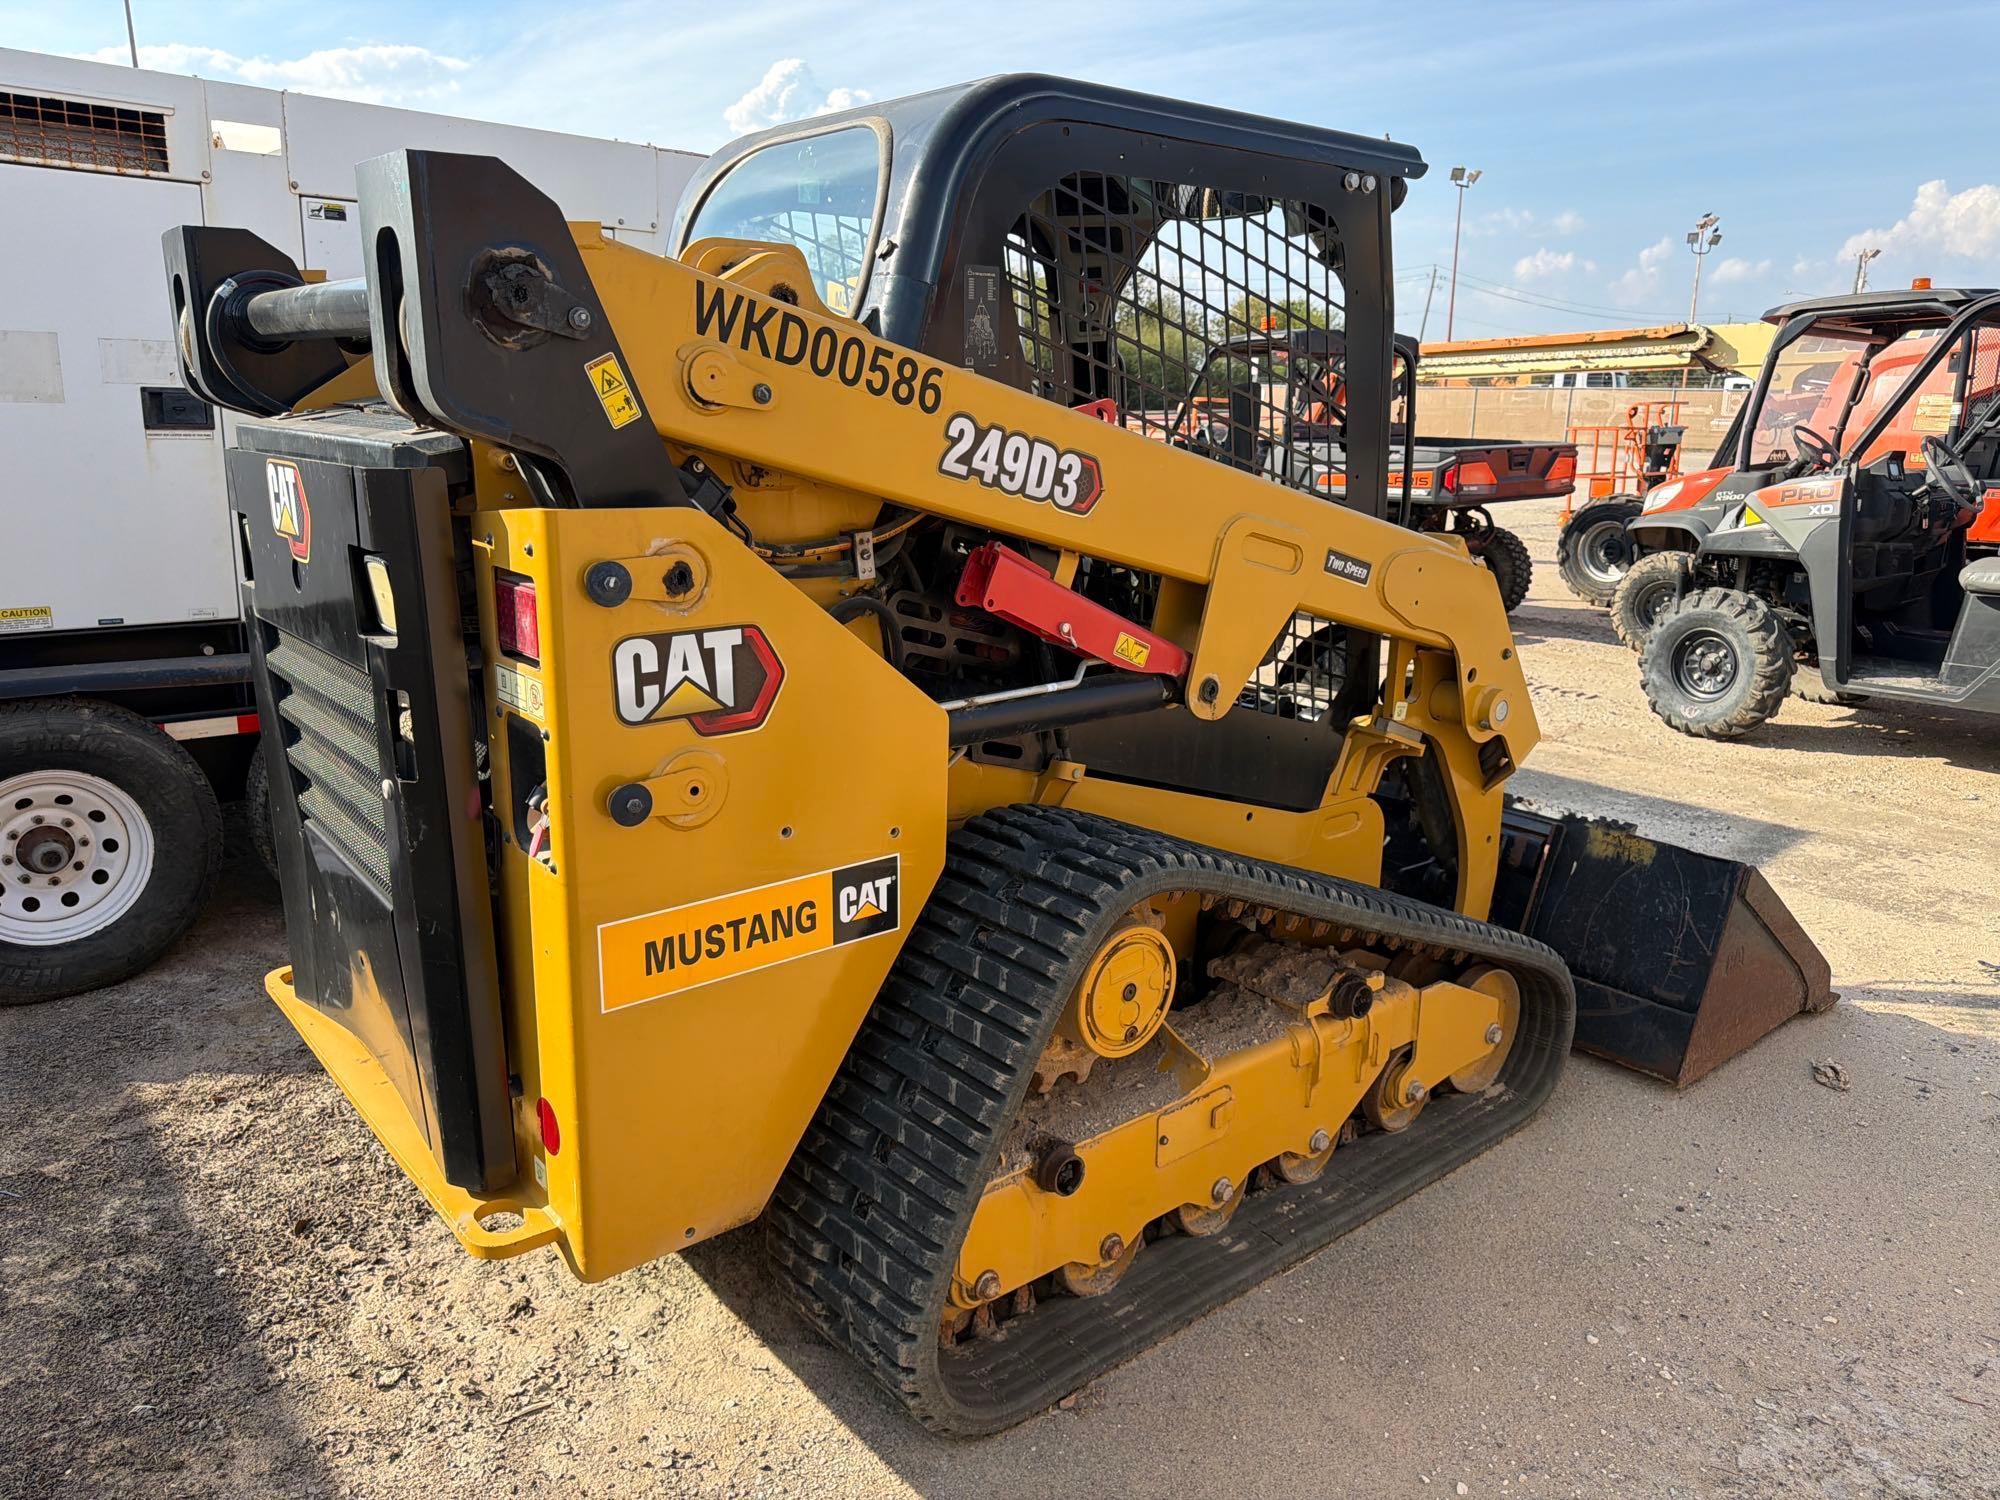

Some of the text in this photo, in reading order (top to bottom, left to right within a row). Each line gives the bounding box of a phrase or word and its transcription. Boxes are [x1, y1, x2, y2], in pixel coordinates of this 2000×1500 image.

[696, 279, 944, 414] WKD00586
[941, 416, 1082, 507] 249D3
[1714, 493, 1745, 501] X900
[1780, 485, 1835, 502] PRO
[266, 462, 300, 536] CAT
[1808, 504, 1833, 516] XD
[1, 608, 48, 618] CAUTION
[615, 628, 743, 722] CAT
[644, 900, 817, 977] MUSTANG
